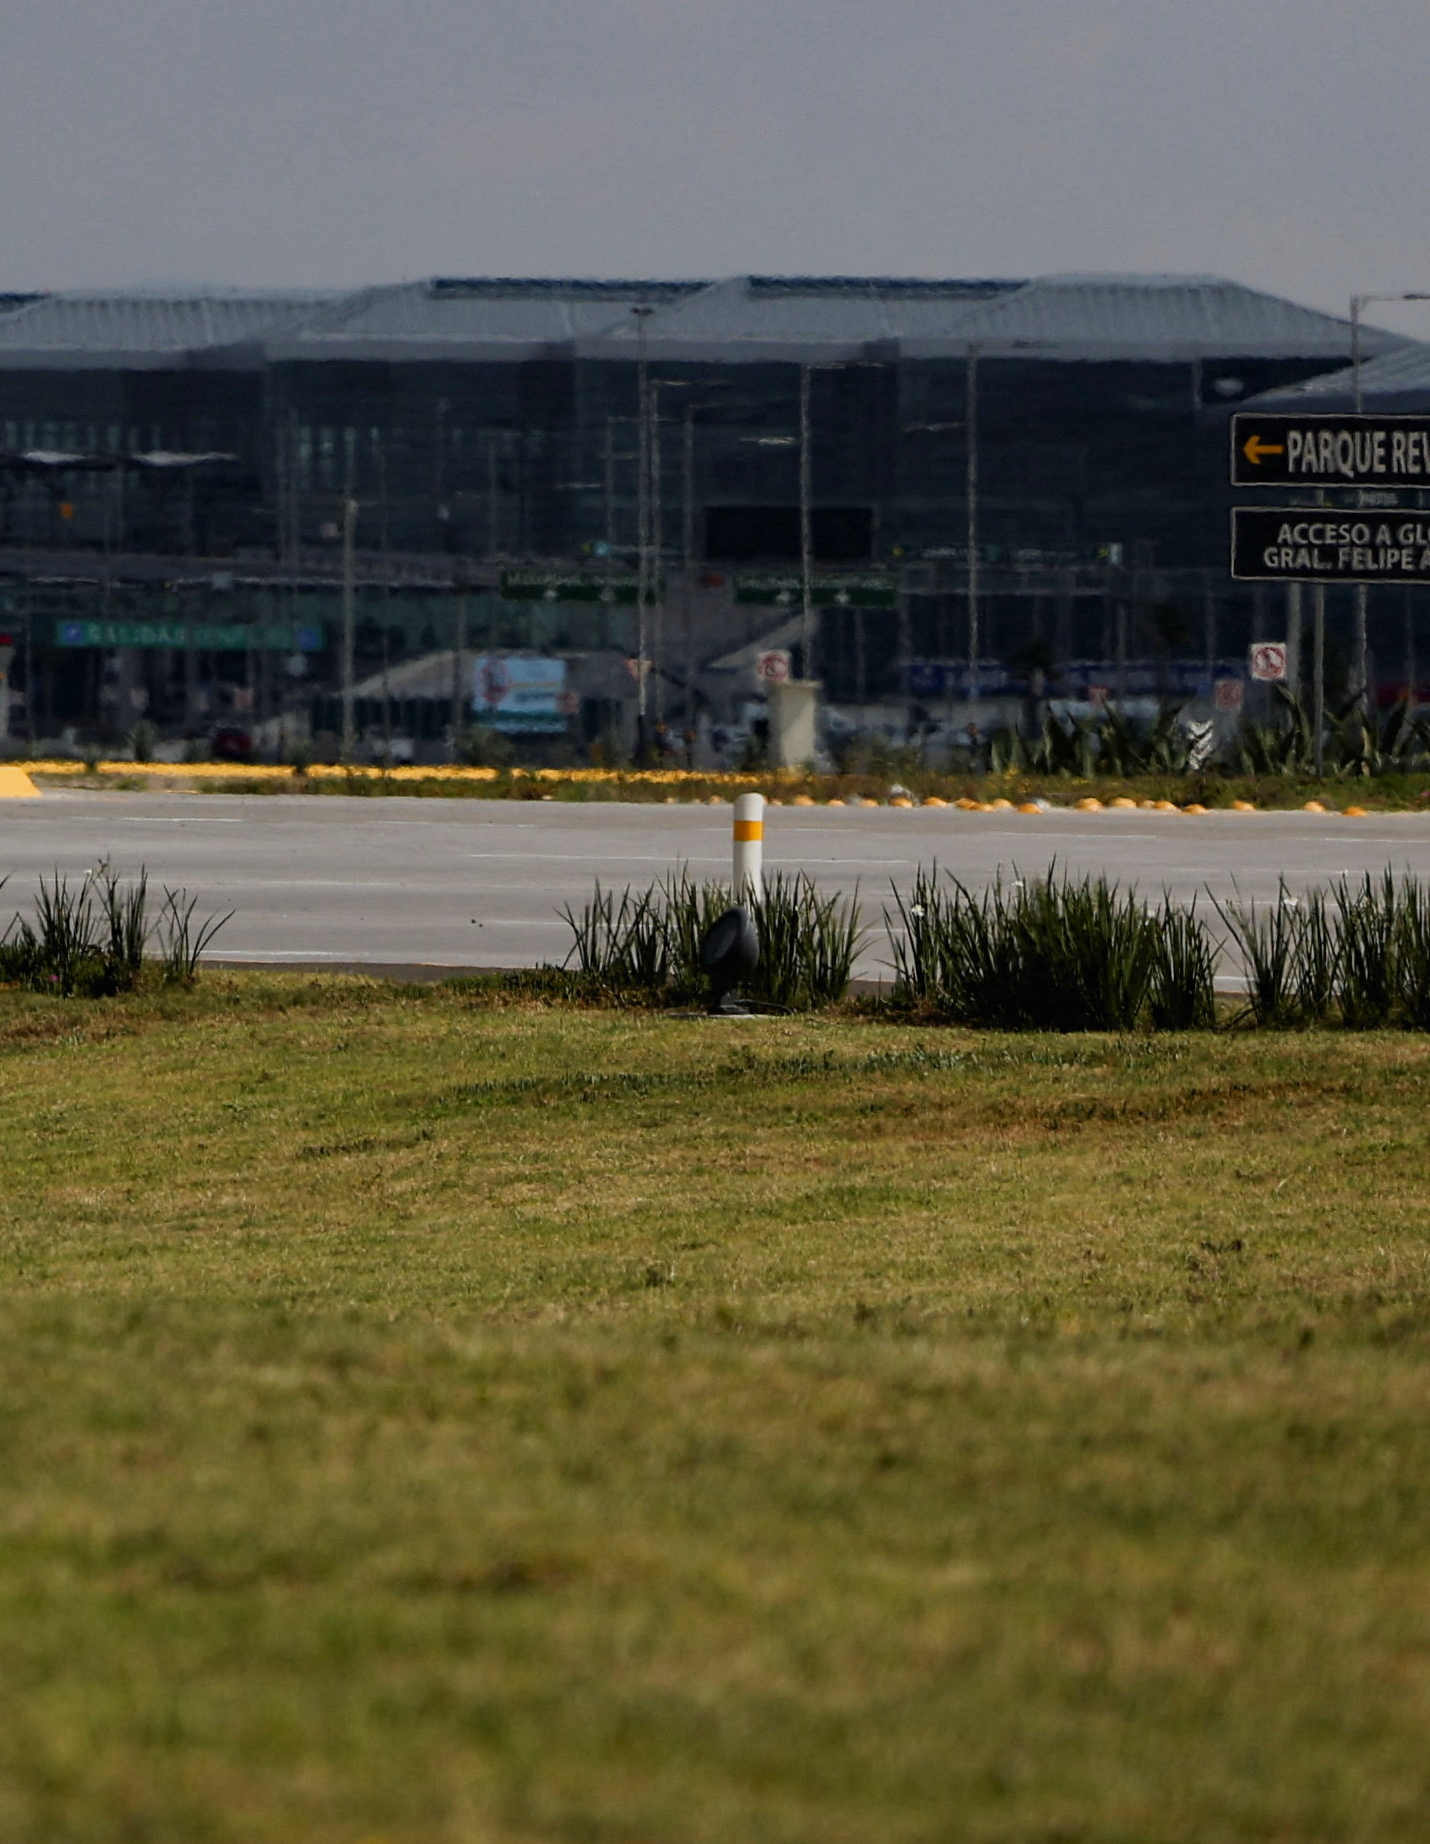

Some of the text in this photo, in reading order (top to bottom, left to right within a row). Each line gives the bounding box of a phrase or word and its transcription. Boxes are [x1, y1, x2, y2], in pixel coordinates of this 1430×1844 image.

[1287, 429, 1386, 478] PARQUE
[1277, 522, 1430, 545] ACCESO A GL
[1263, 546, 1334, 570] GRAL.
[1338, 546, 1413, 571] FELIPE
